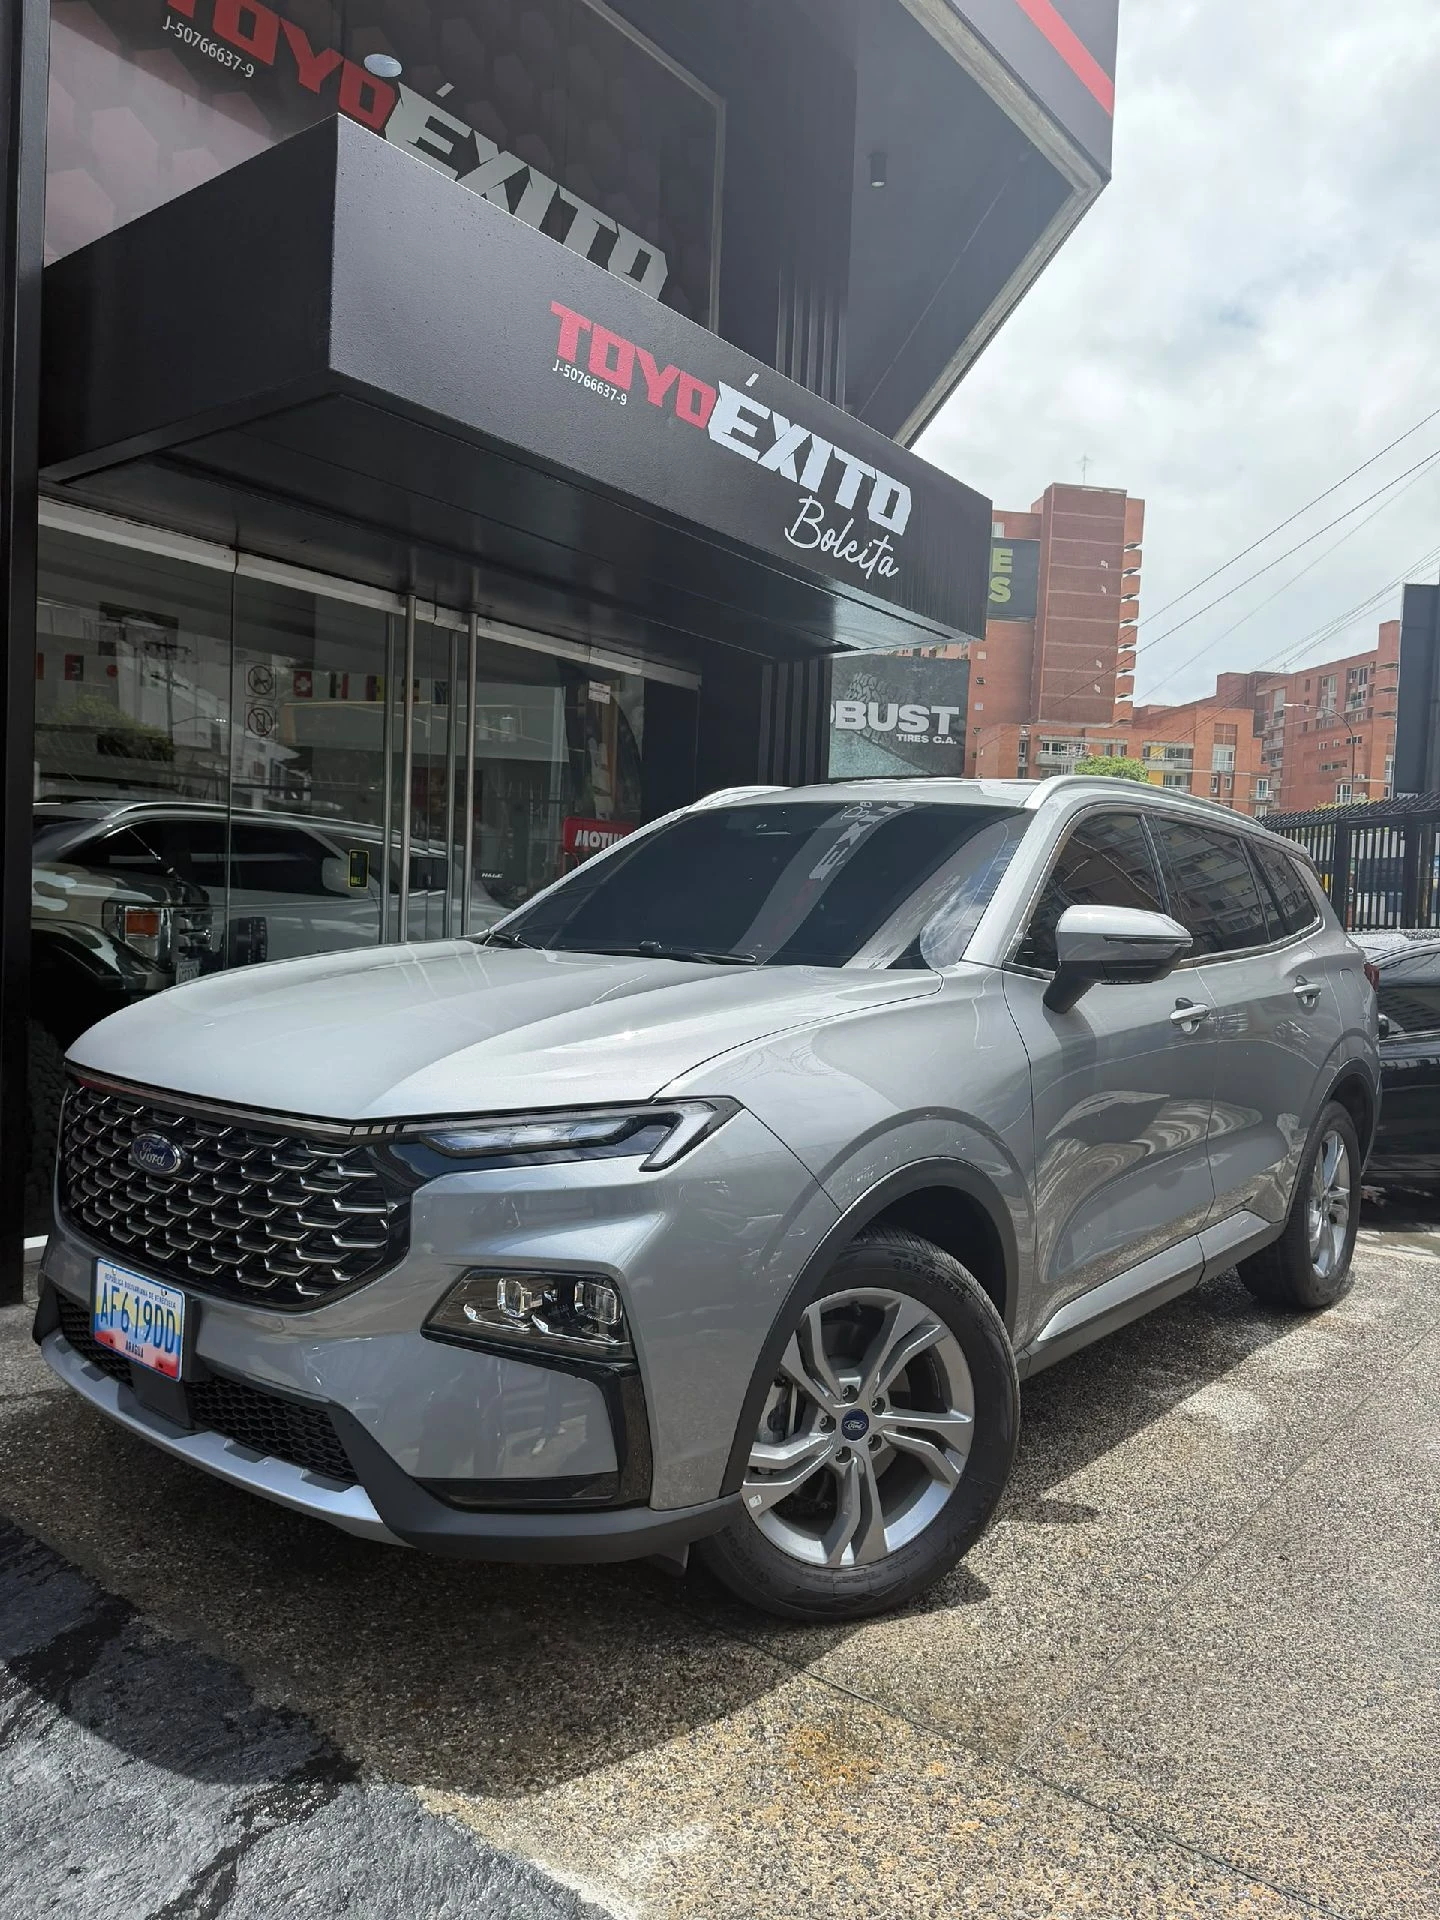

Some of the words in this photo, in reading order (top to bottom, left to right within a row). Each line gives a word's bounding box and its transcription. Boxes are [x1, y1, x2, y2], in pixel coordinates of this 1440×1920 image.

[162, 15, 256, 78] J-50766637-9
[552, 359, 628, 406] J-50766637-9
[830, 700, 960, 735] BUST
[896, 733, 930, 744] TIRES
[139, 1141, 166, 1167] Ford
[100, 1282, 176, 1354] AF619DD
[125, 1341, 145, 1359] ARAGUA
